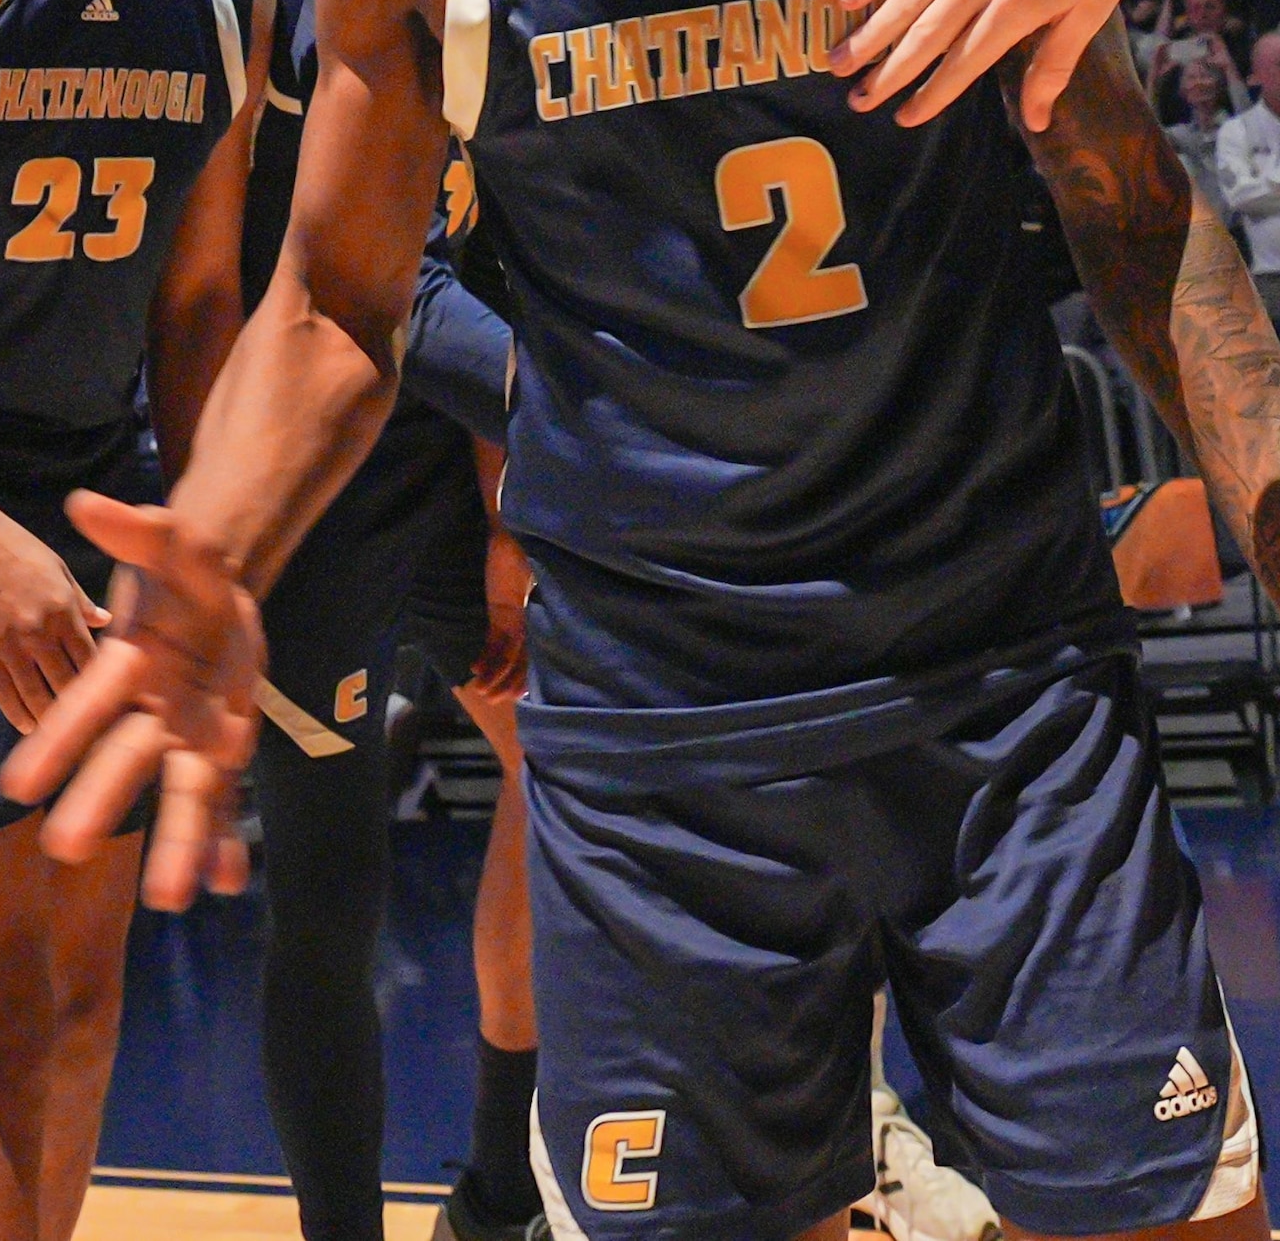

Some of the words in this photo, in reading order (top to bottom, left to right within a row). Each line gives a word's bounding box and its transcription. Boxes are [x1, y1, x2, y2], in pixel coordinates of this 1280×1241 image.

[4, 157, 156, 262] 23
[714, 136, 868, 328] 2
[334, 668, 368, 723] C
[1154, 1086, 1218, 1121] adidas
[580, 1109, 667, 1211] C
